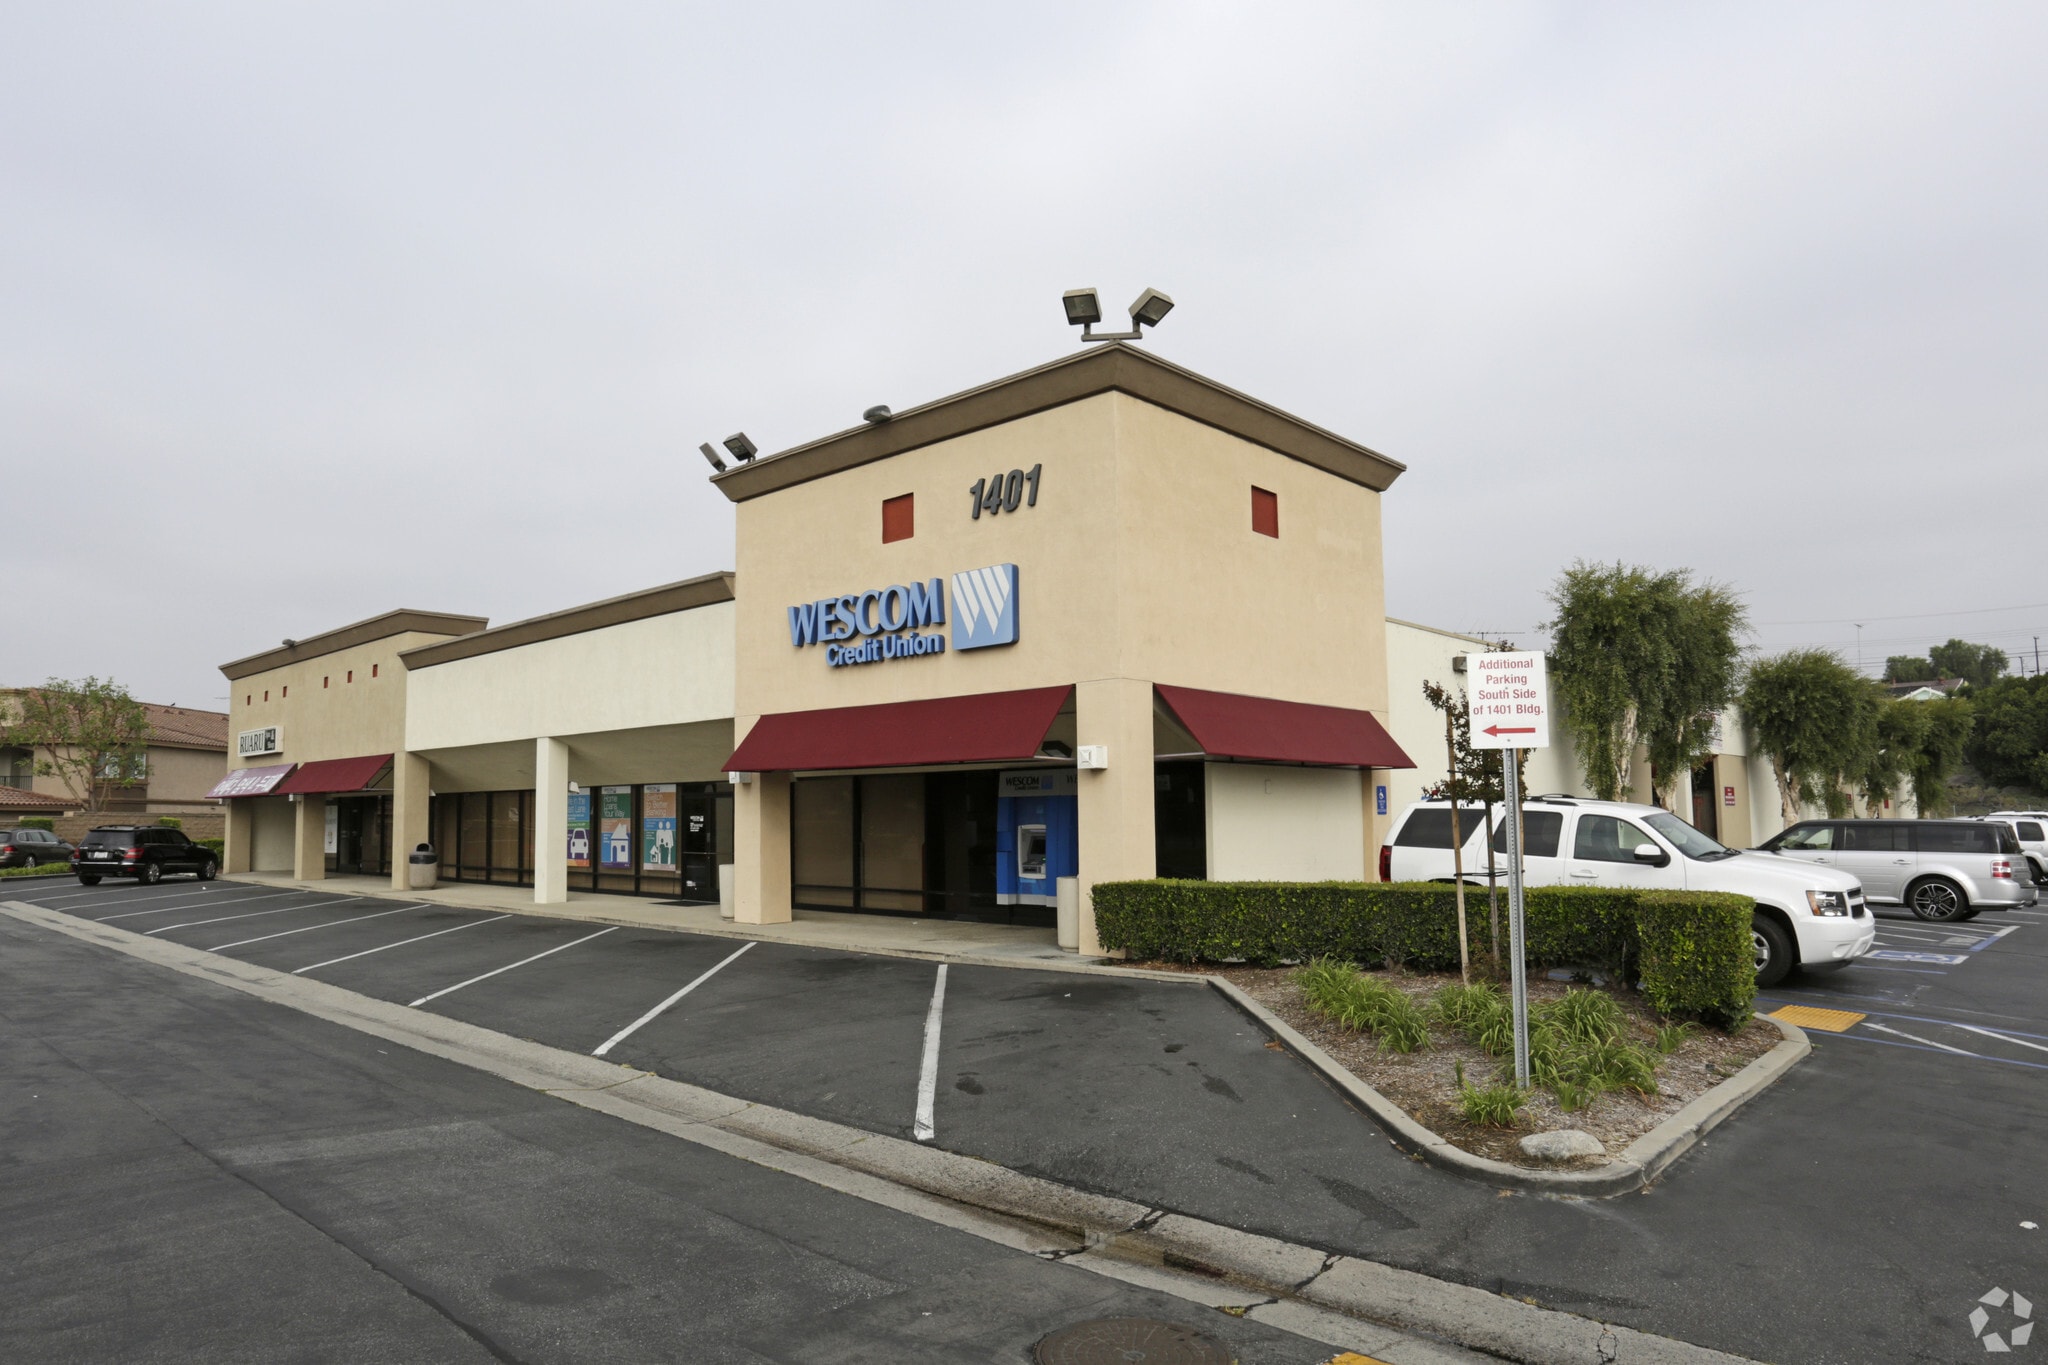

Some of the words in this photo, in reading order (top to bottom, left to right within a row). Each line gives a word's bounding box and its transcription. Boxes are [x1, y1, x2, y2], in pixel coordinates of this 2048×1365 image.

[970, 463, 1042, 520] 1401
[787, 577, 946, 648] WESCOM
[825, 637, 884, 668] Credit
[882, 631, 945, 659] Union
[1479, 658, 1534, 670] Additional
[1486, 674, 1528, 686] Parking
[1478, 689, 1510, 700] South
[1512, 689, 1537, 699] Side
[1473, 705, 1484, 715] of
[1487, 704, 1512, 715] 1401
[1516, 704, 1544, 716] Bldg.
[1005, 776, 1039, 786] WESCOM
[603, 794, 618, 803] Home
